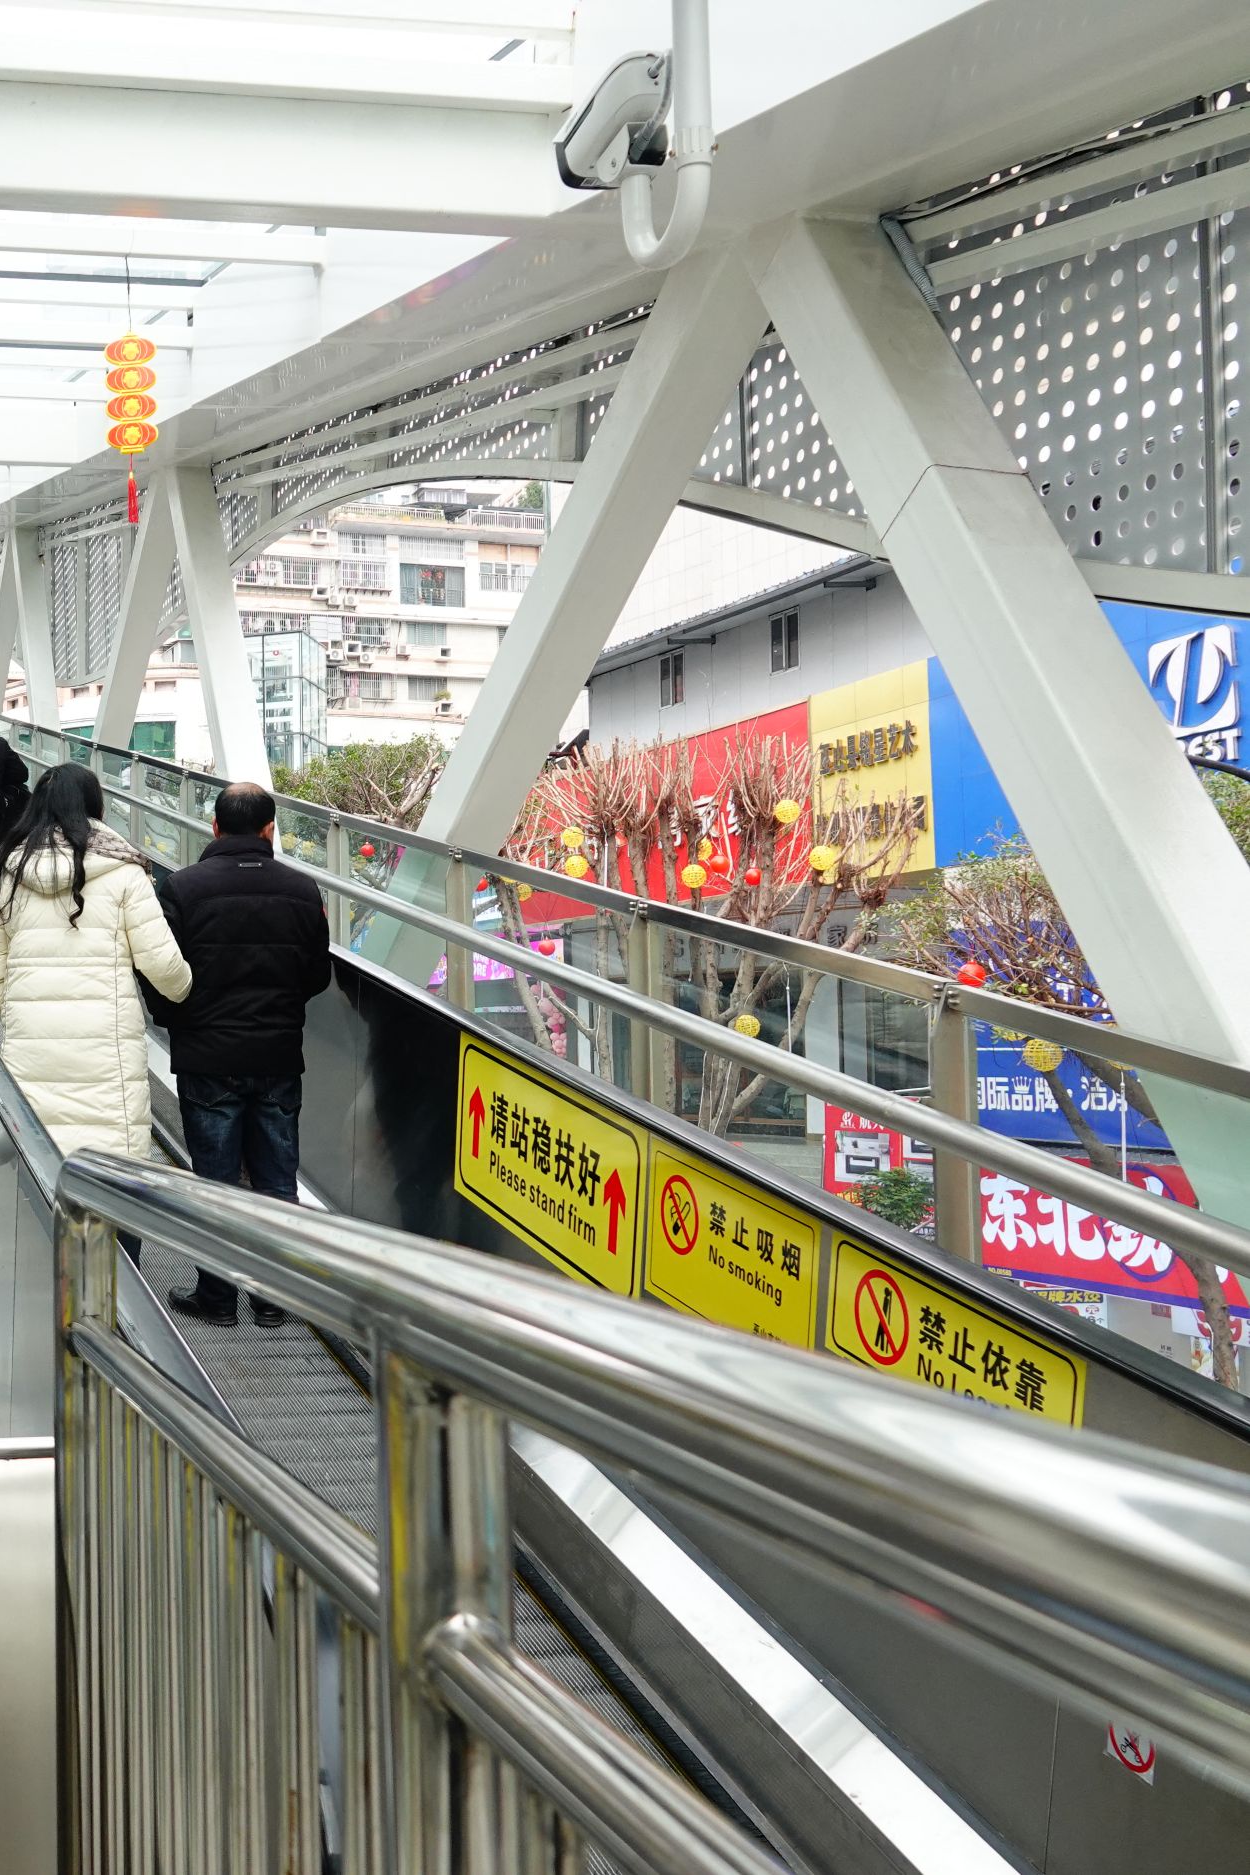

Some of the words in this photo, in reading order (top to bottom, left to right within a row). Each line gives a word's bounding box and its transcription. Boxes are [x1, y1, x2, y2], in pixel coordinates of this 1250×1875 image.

[1174, 728, 1241, 761] EST
[490, 1091, 601, 1207] 请站稳扶好
[489, 1150, 527, 1197] Please
[529, 1183, 565, 1225] stand
[568, 1202, 596, 1247] firm
[708, 1245, 725, 1269] No
[728, 1260, 783, 1307] smoking
[709, 1201, 802, 1281] 禁止吸烟
[917, 1353, 945, 1390] No
[918, 1305, 1048, 1413] 禁止依靠
